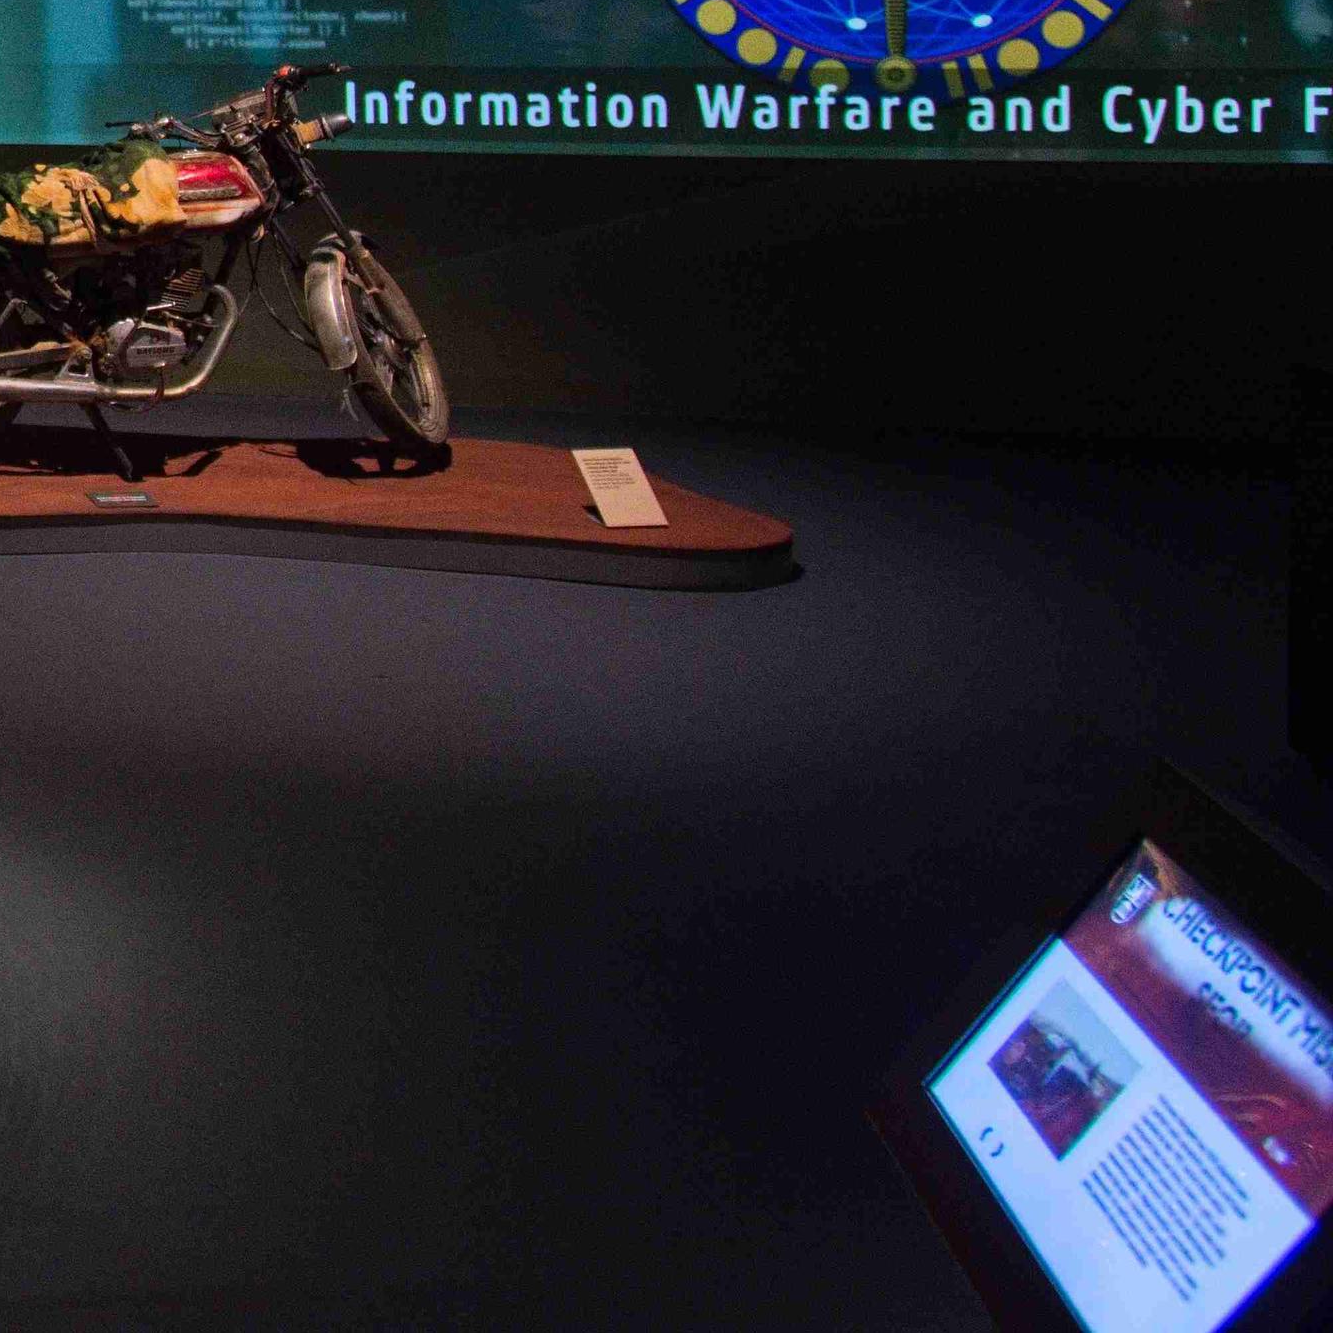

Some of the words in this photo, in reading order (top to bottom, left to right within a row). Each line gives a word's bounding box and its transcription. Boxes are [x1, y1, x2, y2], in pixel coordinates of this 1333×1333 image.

[346, 79, 668, 128] Information
[697, 83, 936, 132] Warfare
[969, 85, 1071, 133] and
[1104, 86, 1271, 144] Cyber
[1163, 897, 1302, 1024] CHECKPOINT
